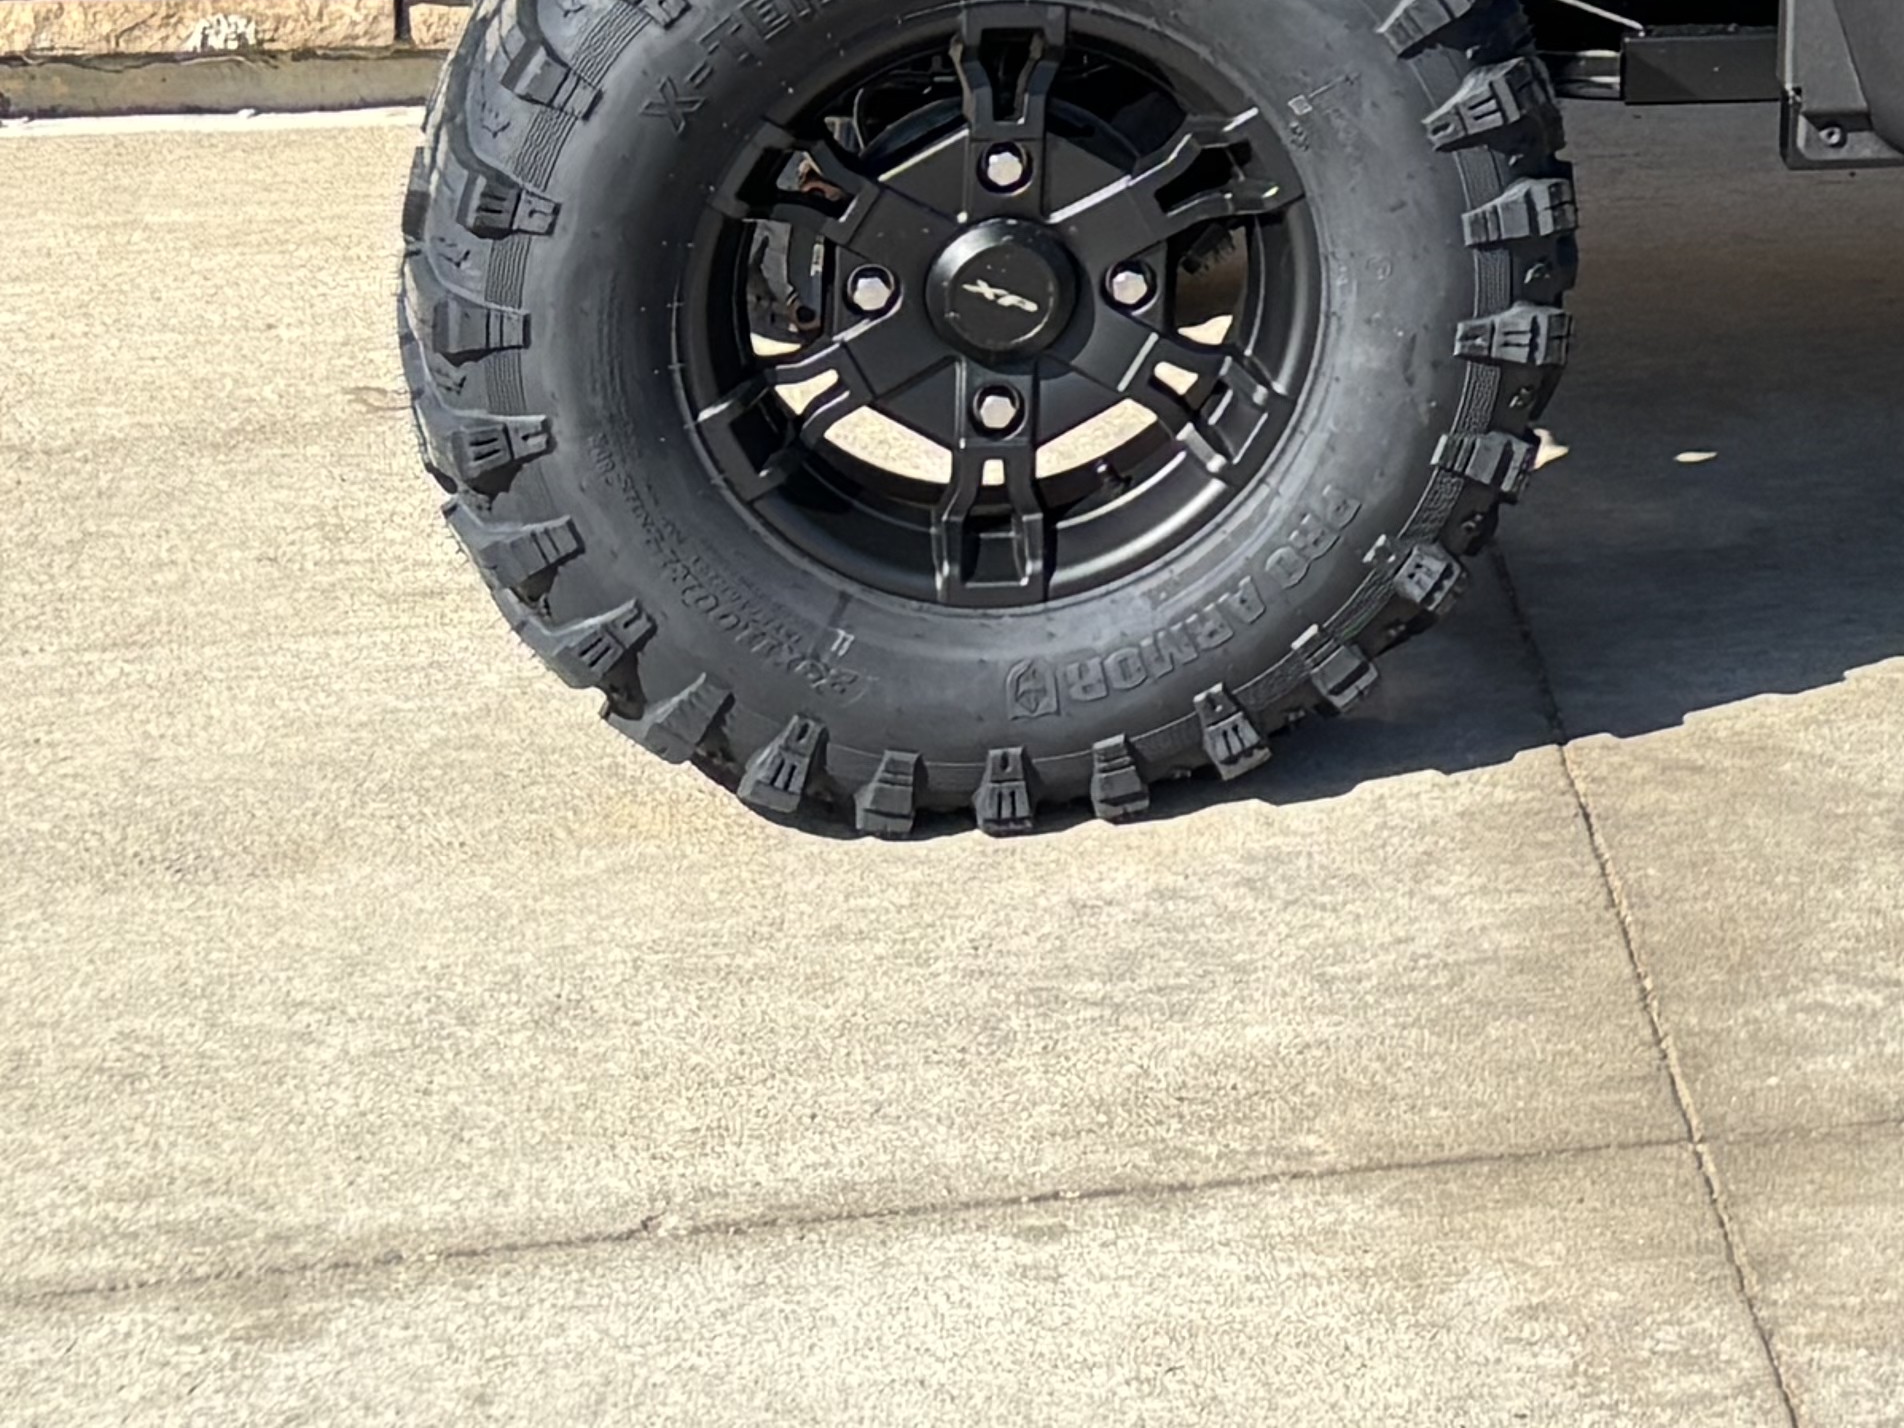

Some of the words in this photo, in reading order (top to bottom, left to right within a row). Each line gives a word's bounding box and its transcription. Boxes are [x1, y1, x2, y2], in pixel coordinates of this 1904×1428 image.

[961, 277, 1039, 313] XP
[1264, 484, 1362, 590] PRO
[1066, 575, 1267, 703] ARMOR
